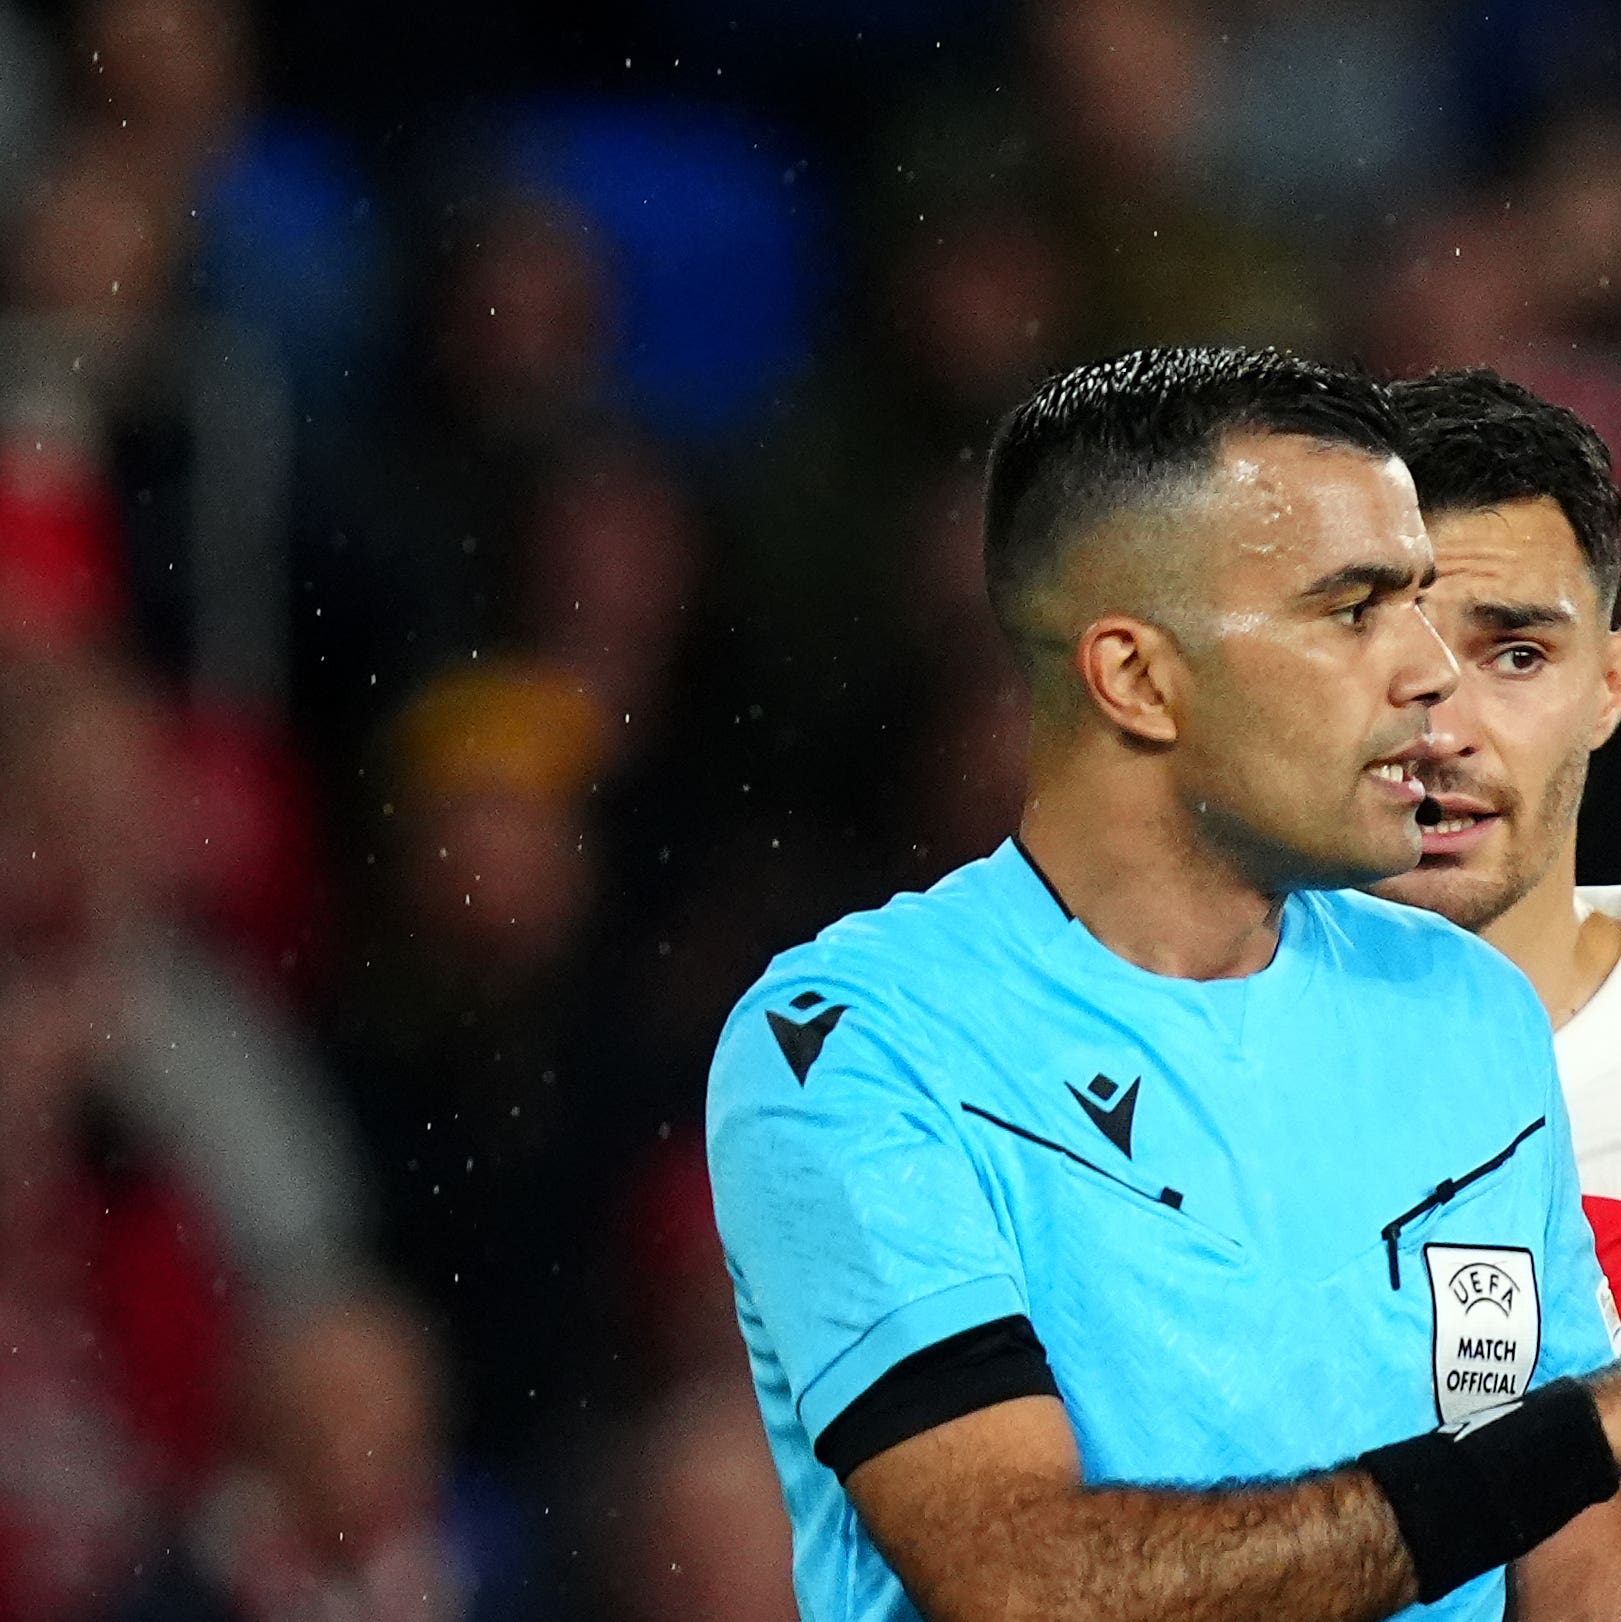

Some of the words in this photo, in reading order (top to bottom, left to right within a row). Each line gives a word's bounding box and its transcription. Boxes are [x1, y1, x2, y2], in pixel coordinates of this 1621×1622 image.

[1453, 1271, 1514, 1311] UEFA
[1457, 1337, 1516, 1362] MATCH
[1446, 1370, 1516, 1395] OFFICIAL
